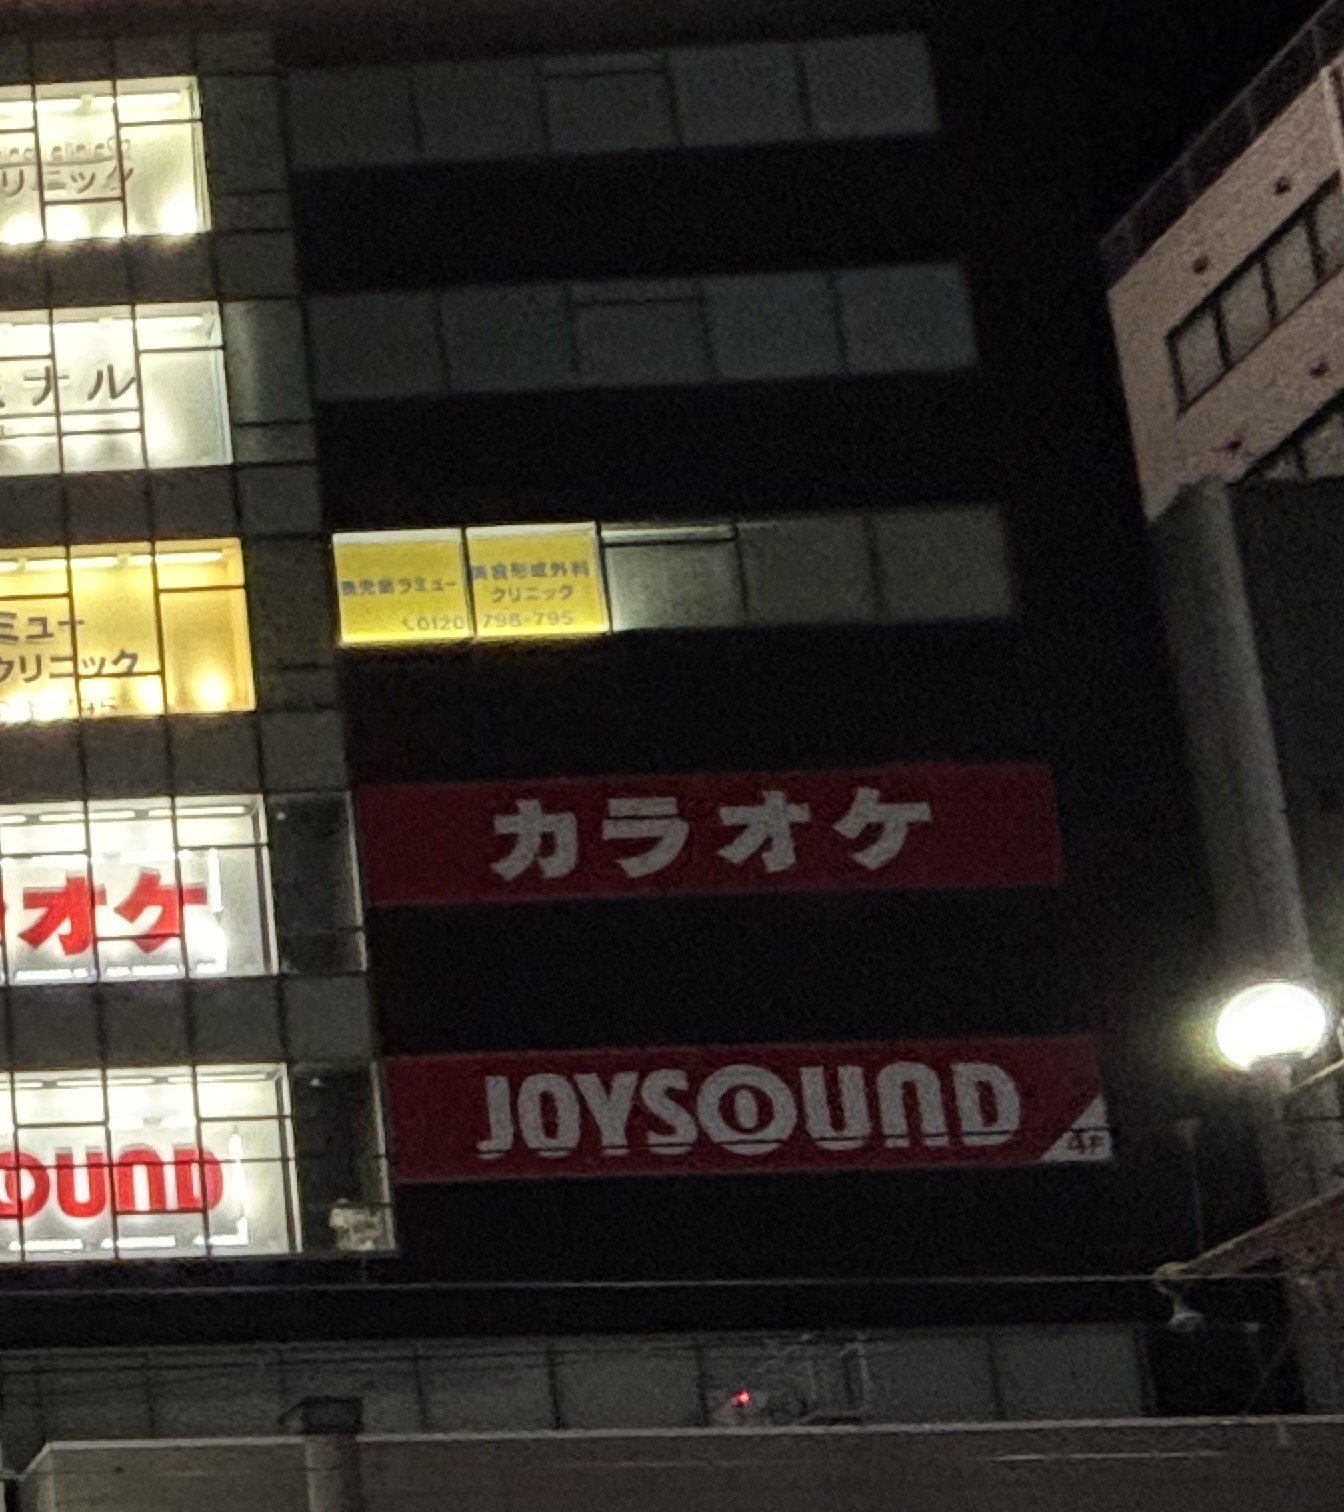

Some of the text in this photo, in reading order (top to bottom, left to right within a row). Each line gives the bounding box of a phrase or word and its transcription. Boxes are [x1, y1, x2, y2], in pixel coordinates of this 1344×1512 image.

[488, 786, 934, 882] カラオケ
[475, 1061, 1023, 1160] JOYSOUND
